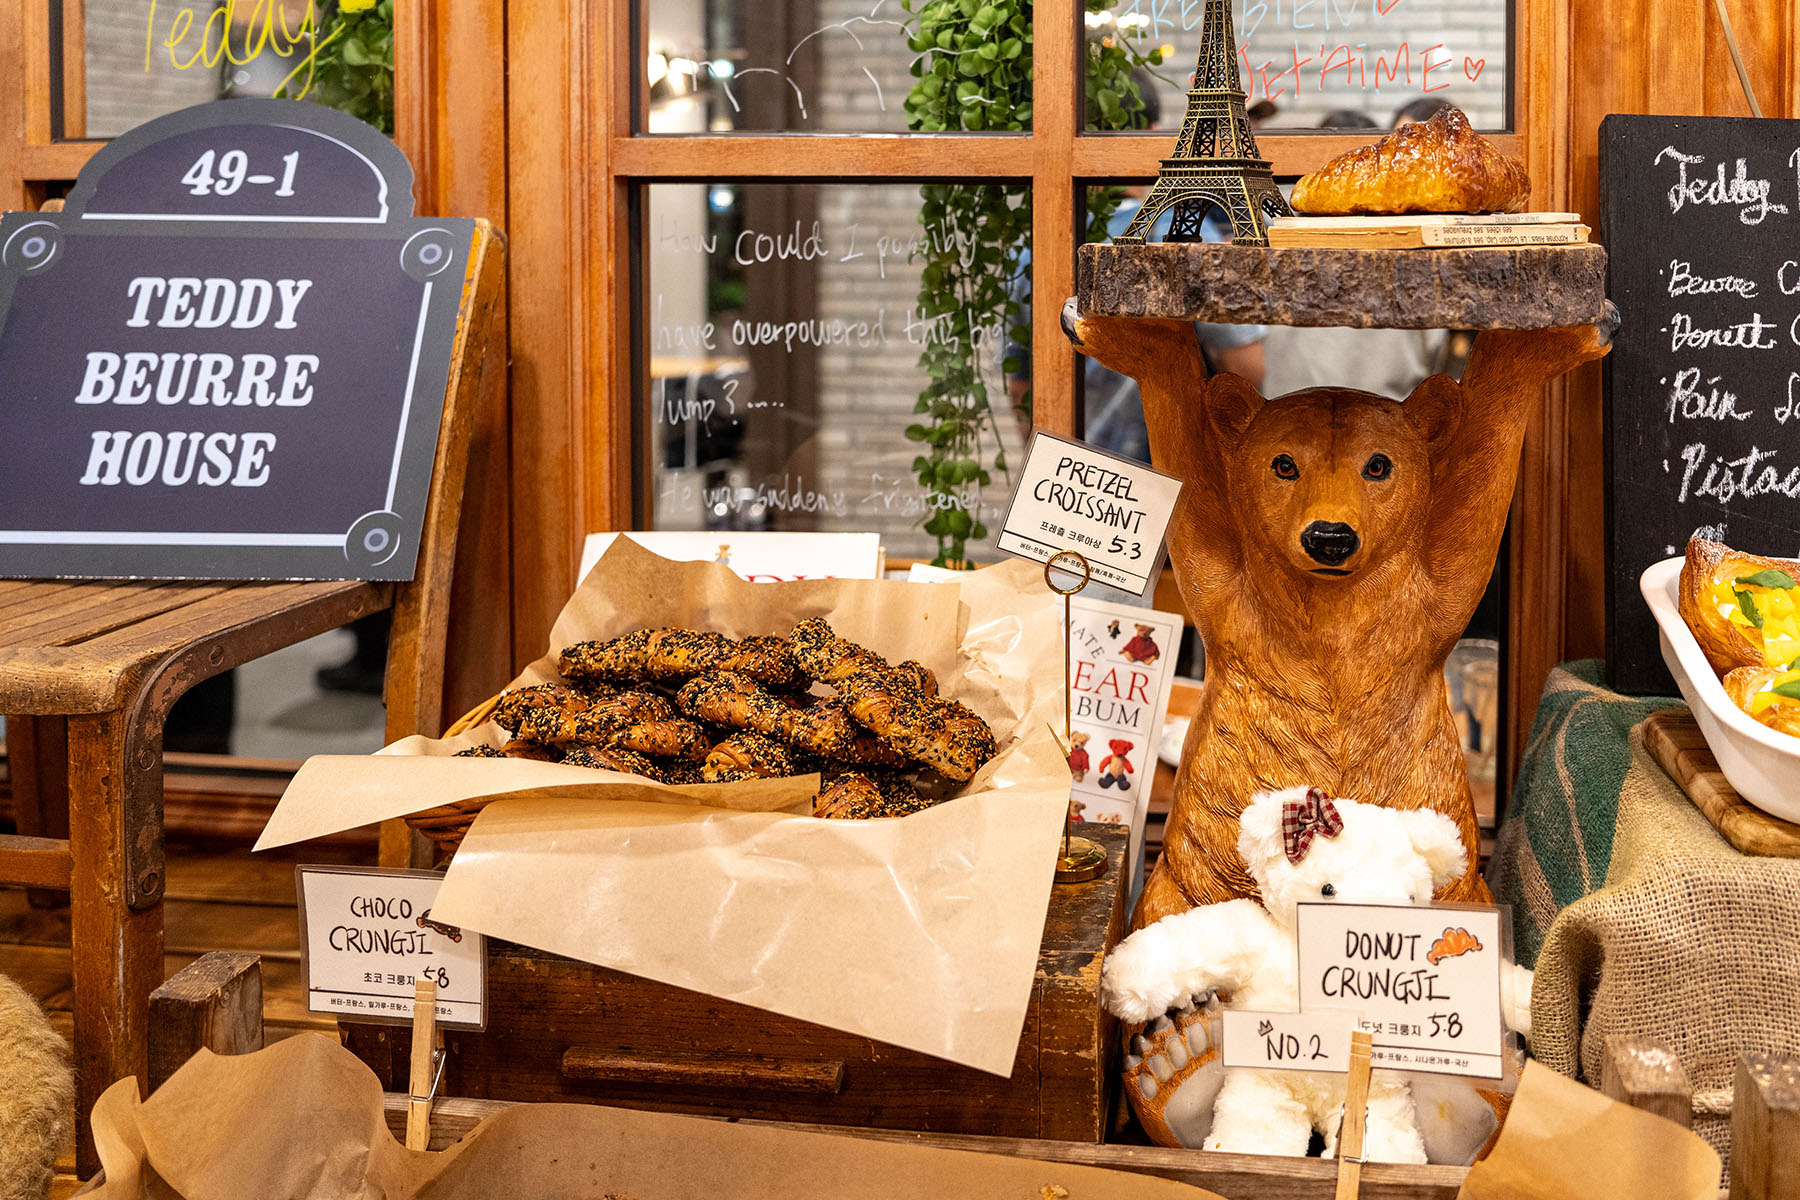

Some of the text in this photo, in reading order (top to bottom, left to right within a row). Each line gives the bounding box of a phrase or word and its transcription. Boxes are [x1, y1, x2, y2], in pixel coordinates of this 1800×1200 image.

[181, 149, 299, 197] 49-1
[734, 219, 828, 265] could
[839, 223, 864, 262] I
[126, 276, 313, 330] TEDDY
[733, 308, 888, 353] overpowered
[903, 307, 959, 354] this
[75, 351, 320, 407] BEURRE
[79, 430, 277, 487] HOUSE
[1055, 457, 1138, 502] PRETZEL
[1033, 479, 1147, 534] CROISSANT
[1067, 531, 1102, 549] 크루아상
[1107, 535, 1142, 560] 5.3
[1072, 660, 1151, 705] EAR
[1076, 695, 1142, 728] BUM
[350, 896, 413, 919] CHOCO
[329, 926, 433, 956] CRUNGJI
[1345, 928, 1421, 961] DONUT
[364, 972, 382, 983] 초코
[387, 974, 415, 986] 크룽지
[1322, 966, 1450, 1004] CRUNGJI
[1388, 1023, 1421, 1036] 크룽지
[1427, 1012, 1463, 1038] 5.8
